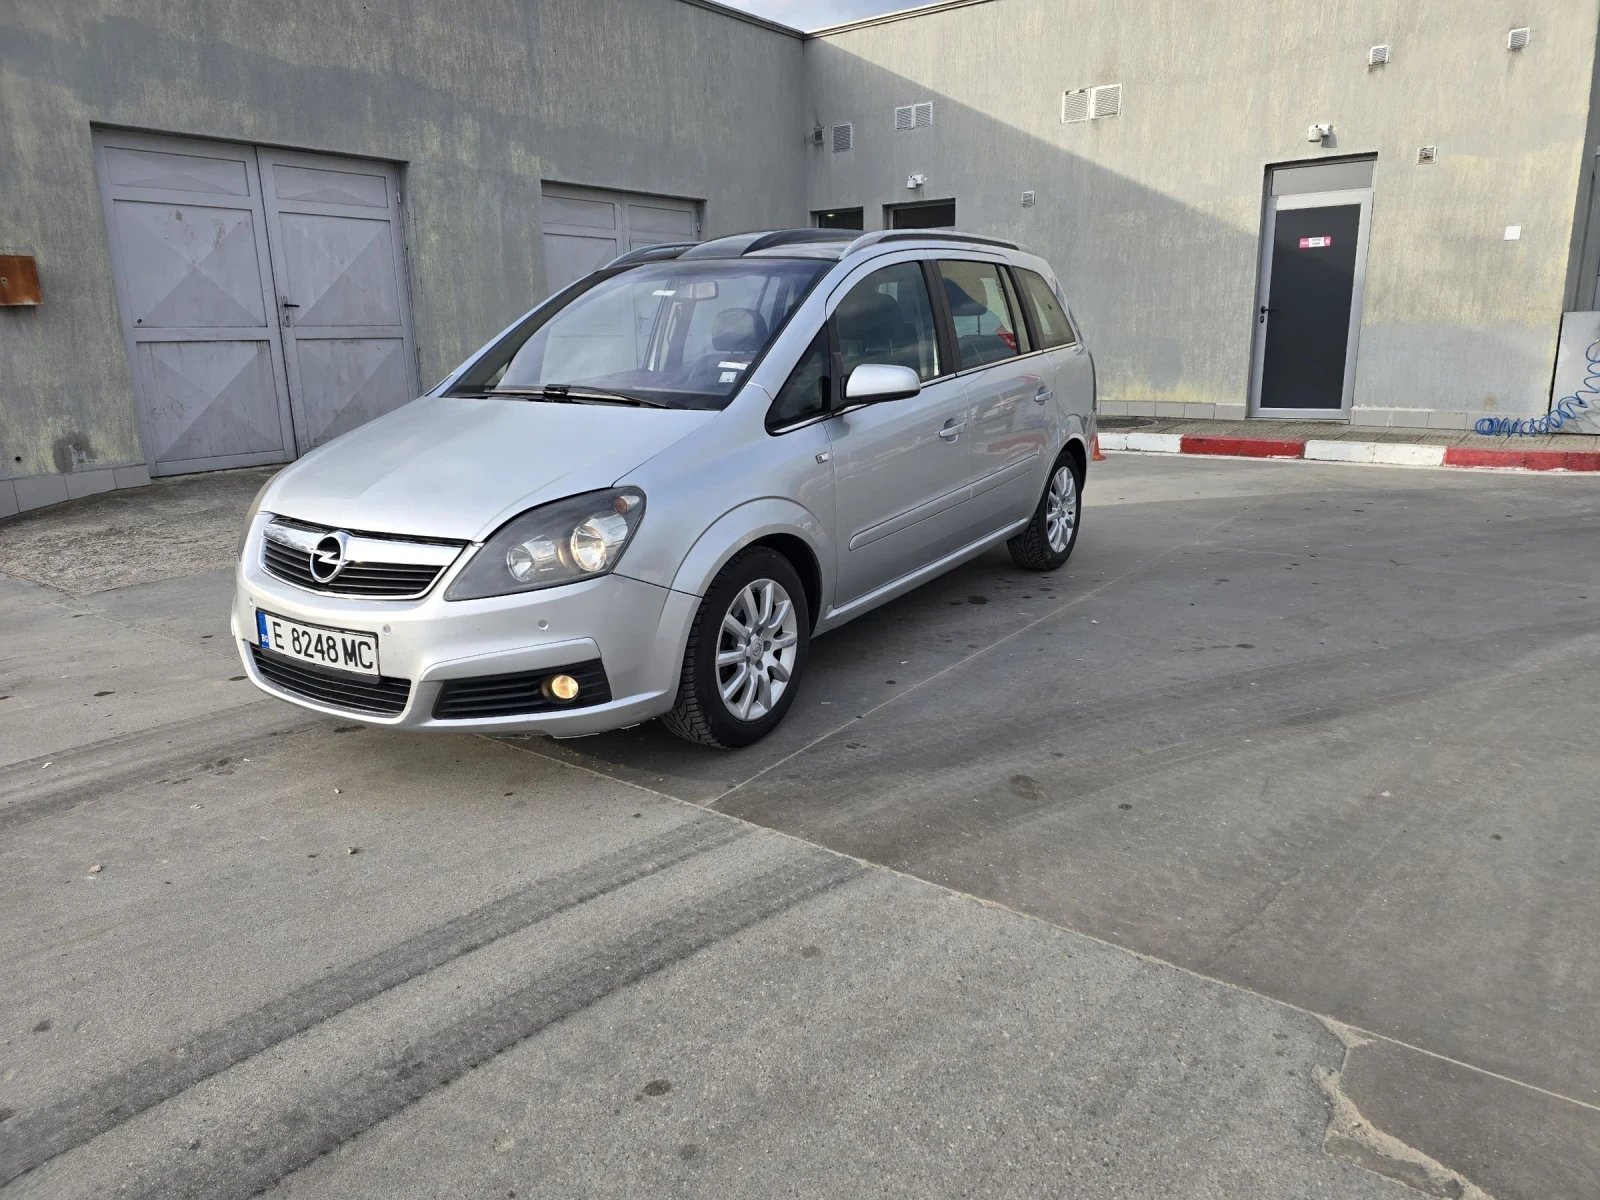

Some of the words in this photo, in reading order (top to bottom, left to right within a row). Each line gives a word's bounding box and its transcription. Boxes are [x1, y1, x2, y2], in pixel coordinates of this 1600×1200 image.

[261, 633, 269, 643] BG
[272, 621, 284, 650] E
[291, 627, 339, 663] 8248
[341, 637, 373, 669] MC
